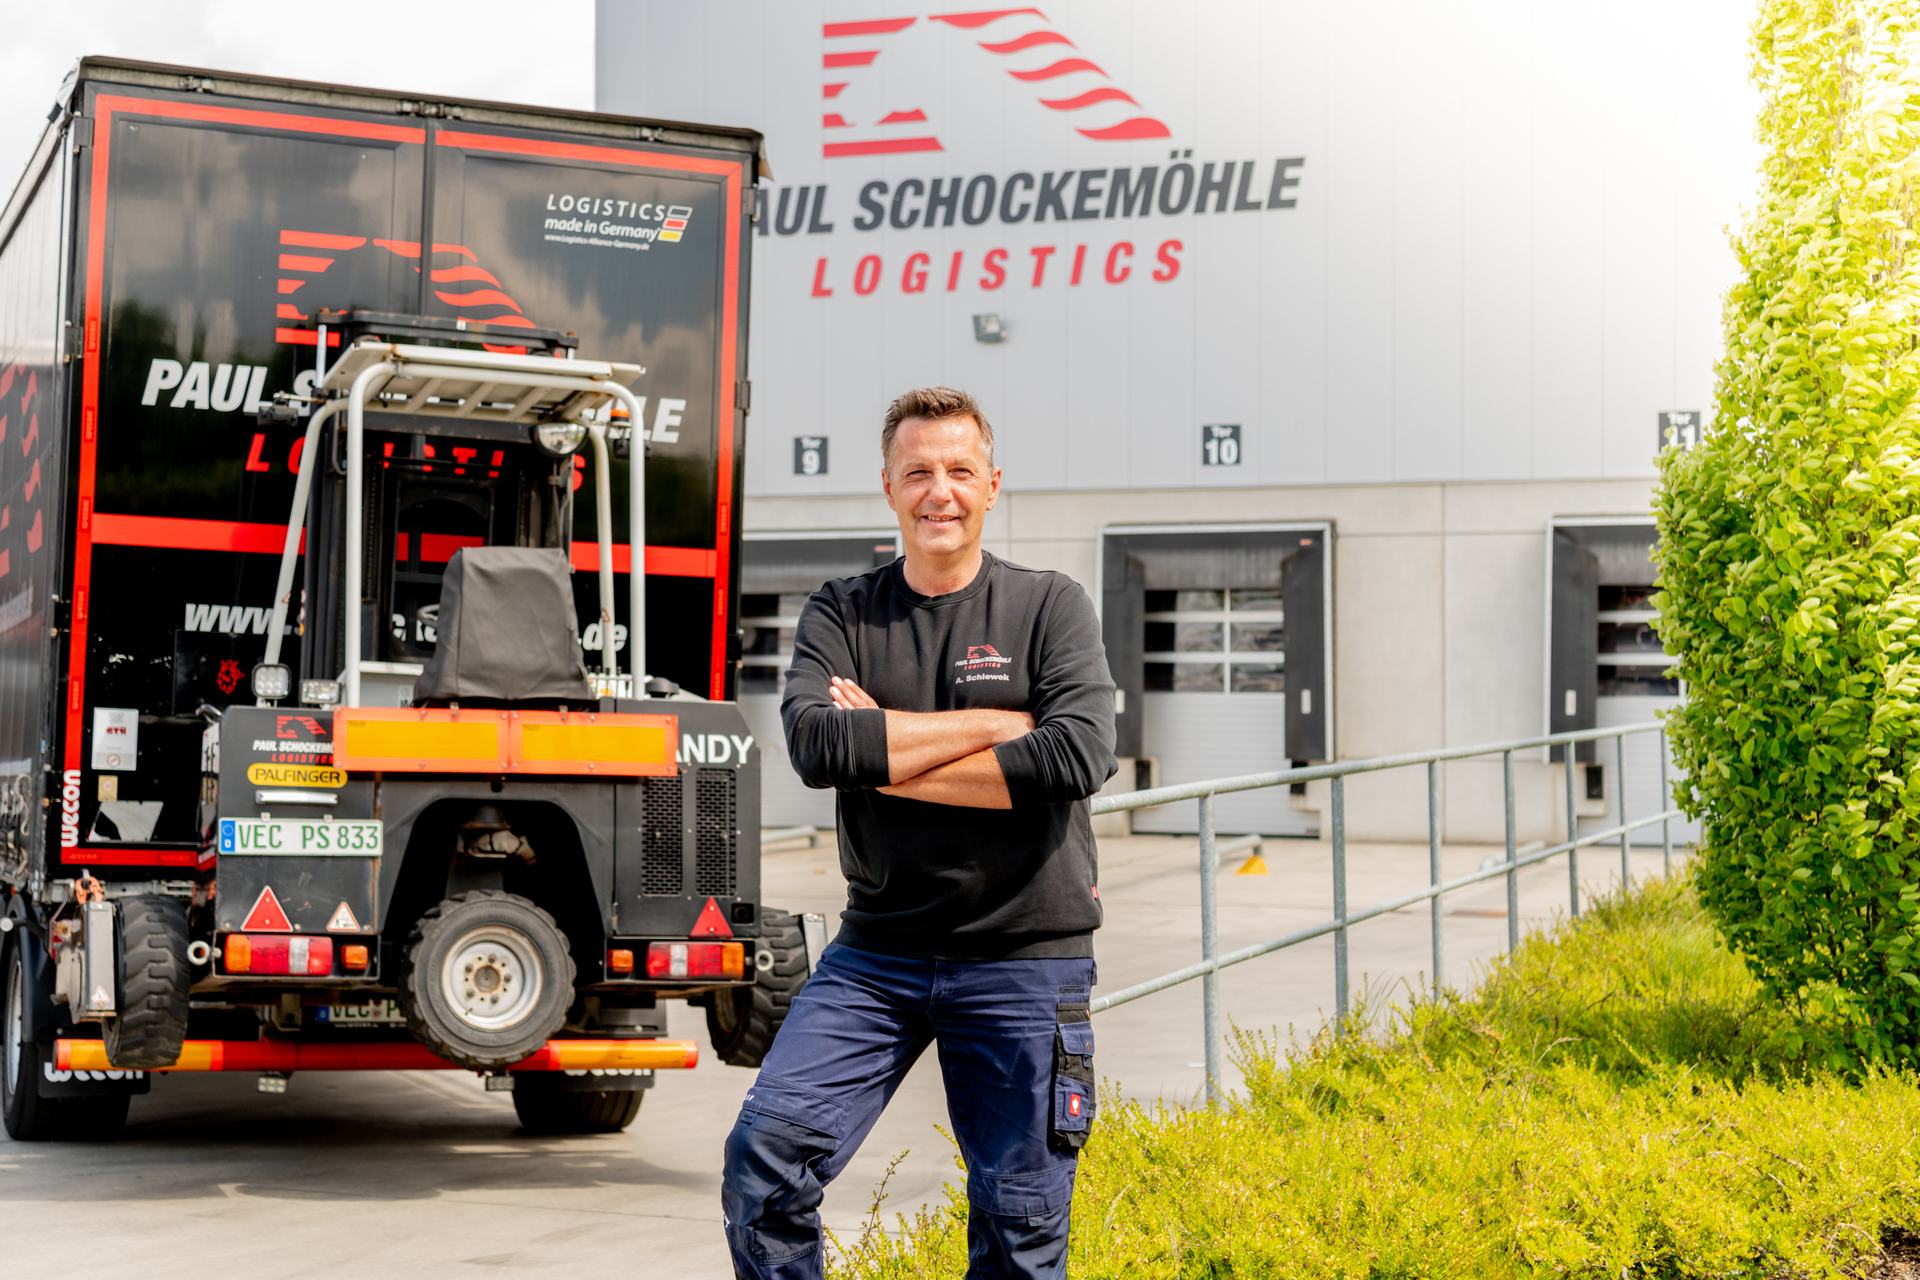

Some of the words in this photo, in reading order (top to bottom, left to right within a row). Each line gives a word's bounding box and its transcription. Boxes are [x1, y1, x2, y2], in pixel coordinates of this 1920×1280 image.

[752, 185, 834, 236] AUL
[853, 148, 1306, 231] SCHOCKEMÖHLE
[546, 193, 666, 221] LOGISTICS
[544, 217, 582, 232] made
[584, 220, 597, 234] in
[599, 221, 657, 242] Germany
[811, 238, 1184, 299] LOGISTICS
[141, 358, 274, 413] PAUL
[1667, 411, 1692, 425] Tor
[801, 436, 822, 449] Tor
[1210, 425, 1233, 438] Tor
[802, 450, 820, 475] 9
[1205, 438, 1239, 465] 10
[253, 740, 277, 751] PAUL
[676, 733, 754, 764] NDY
[255, 768, 340, 783] PALFINGER
[61, 769, 81, 848] wecon
[238, 825, 282, 849] VEC
[301, 825, 330, 849] PS
[337, 825, 378, 849] 833
